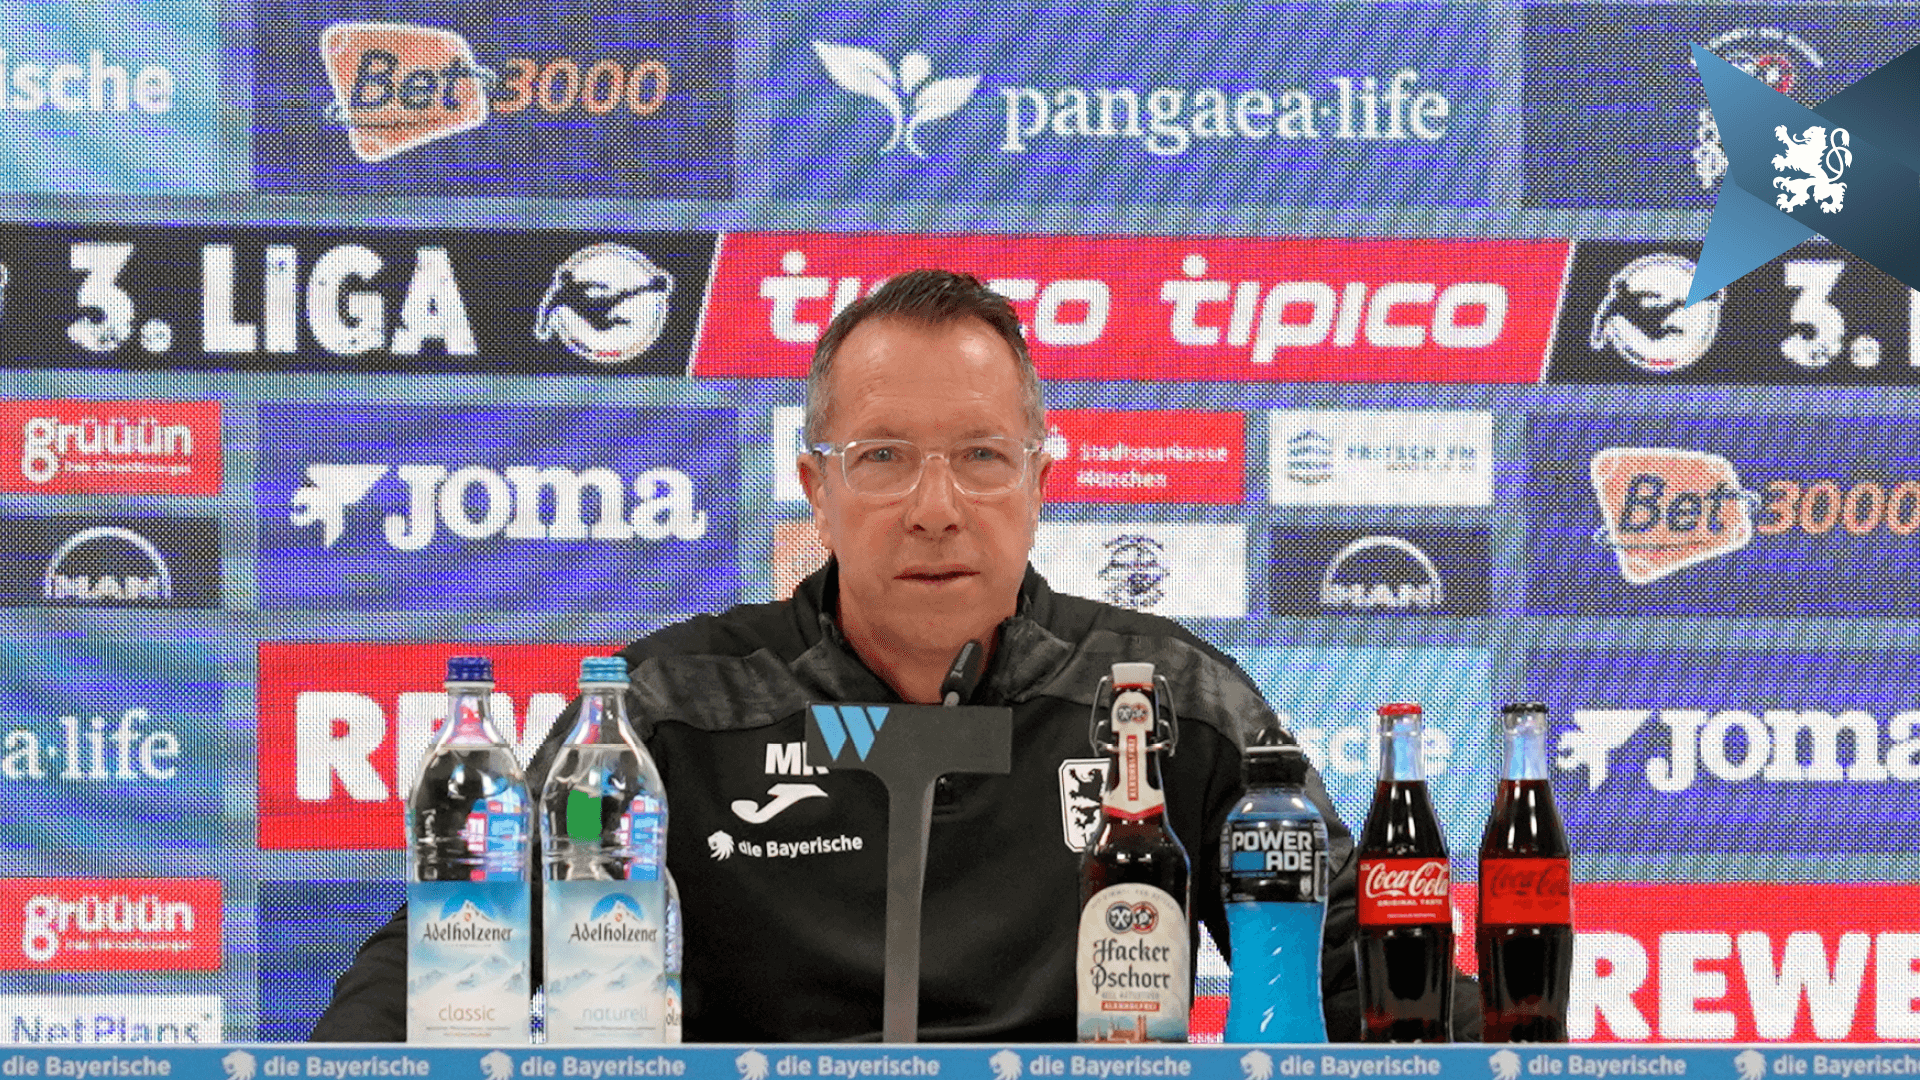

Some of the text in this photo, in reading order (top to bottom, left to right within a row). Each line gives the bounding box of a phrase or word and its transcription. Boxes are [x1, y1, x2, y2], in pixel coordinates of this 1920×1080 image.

[351, 49, 670, 114] Bet 3000
[67, 242, 478, 355] 3. LIGA
[1160, 253, 1509, 363] tipico
[1780, 259, 1881, 368] 3.
[1618, 472, 1732, 535] Bet
[54, 574, 163, 600] MAN
[1330, 582, 1433, 607] MAN
[738, 835, 863, 858] die Bayerische
[1232, 831, 1313, 851] POWER
[1266, 851, 1313, 871] ADE
[421, 923, 515, 943] Adelholzener
[568, 922, 659, 943] Adelholzener
[1093, 938, 1170, 966] Hacker
[1090, 964, 1170, 994] Pschorr
[438, 1004, 496, 1022] classic
[582, 1004, 649, 1021] naturell
[3, 1056, 171, 1079] die Bayerische
[264, 1056, 429, 1079] die Bayerische
[521, 1056, 685, 1079] die Bayerische
[777, 1056, 940, 1078] die Bayerische
[1030, 1055, 1191, 1078] die Bayerische
[1280, 1055, 1440, 1078] die Bayerische
[1528, 1055, 1686, 1078] die Bayerische
[1774, 1055, 1920, 1077] die Bayerisch
